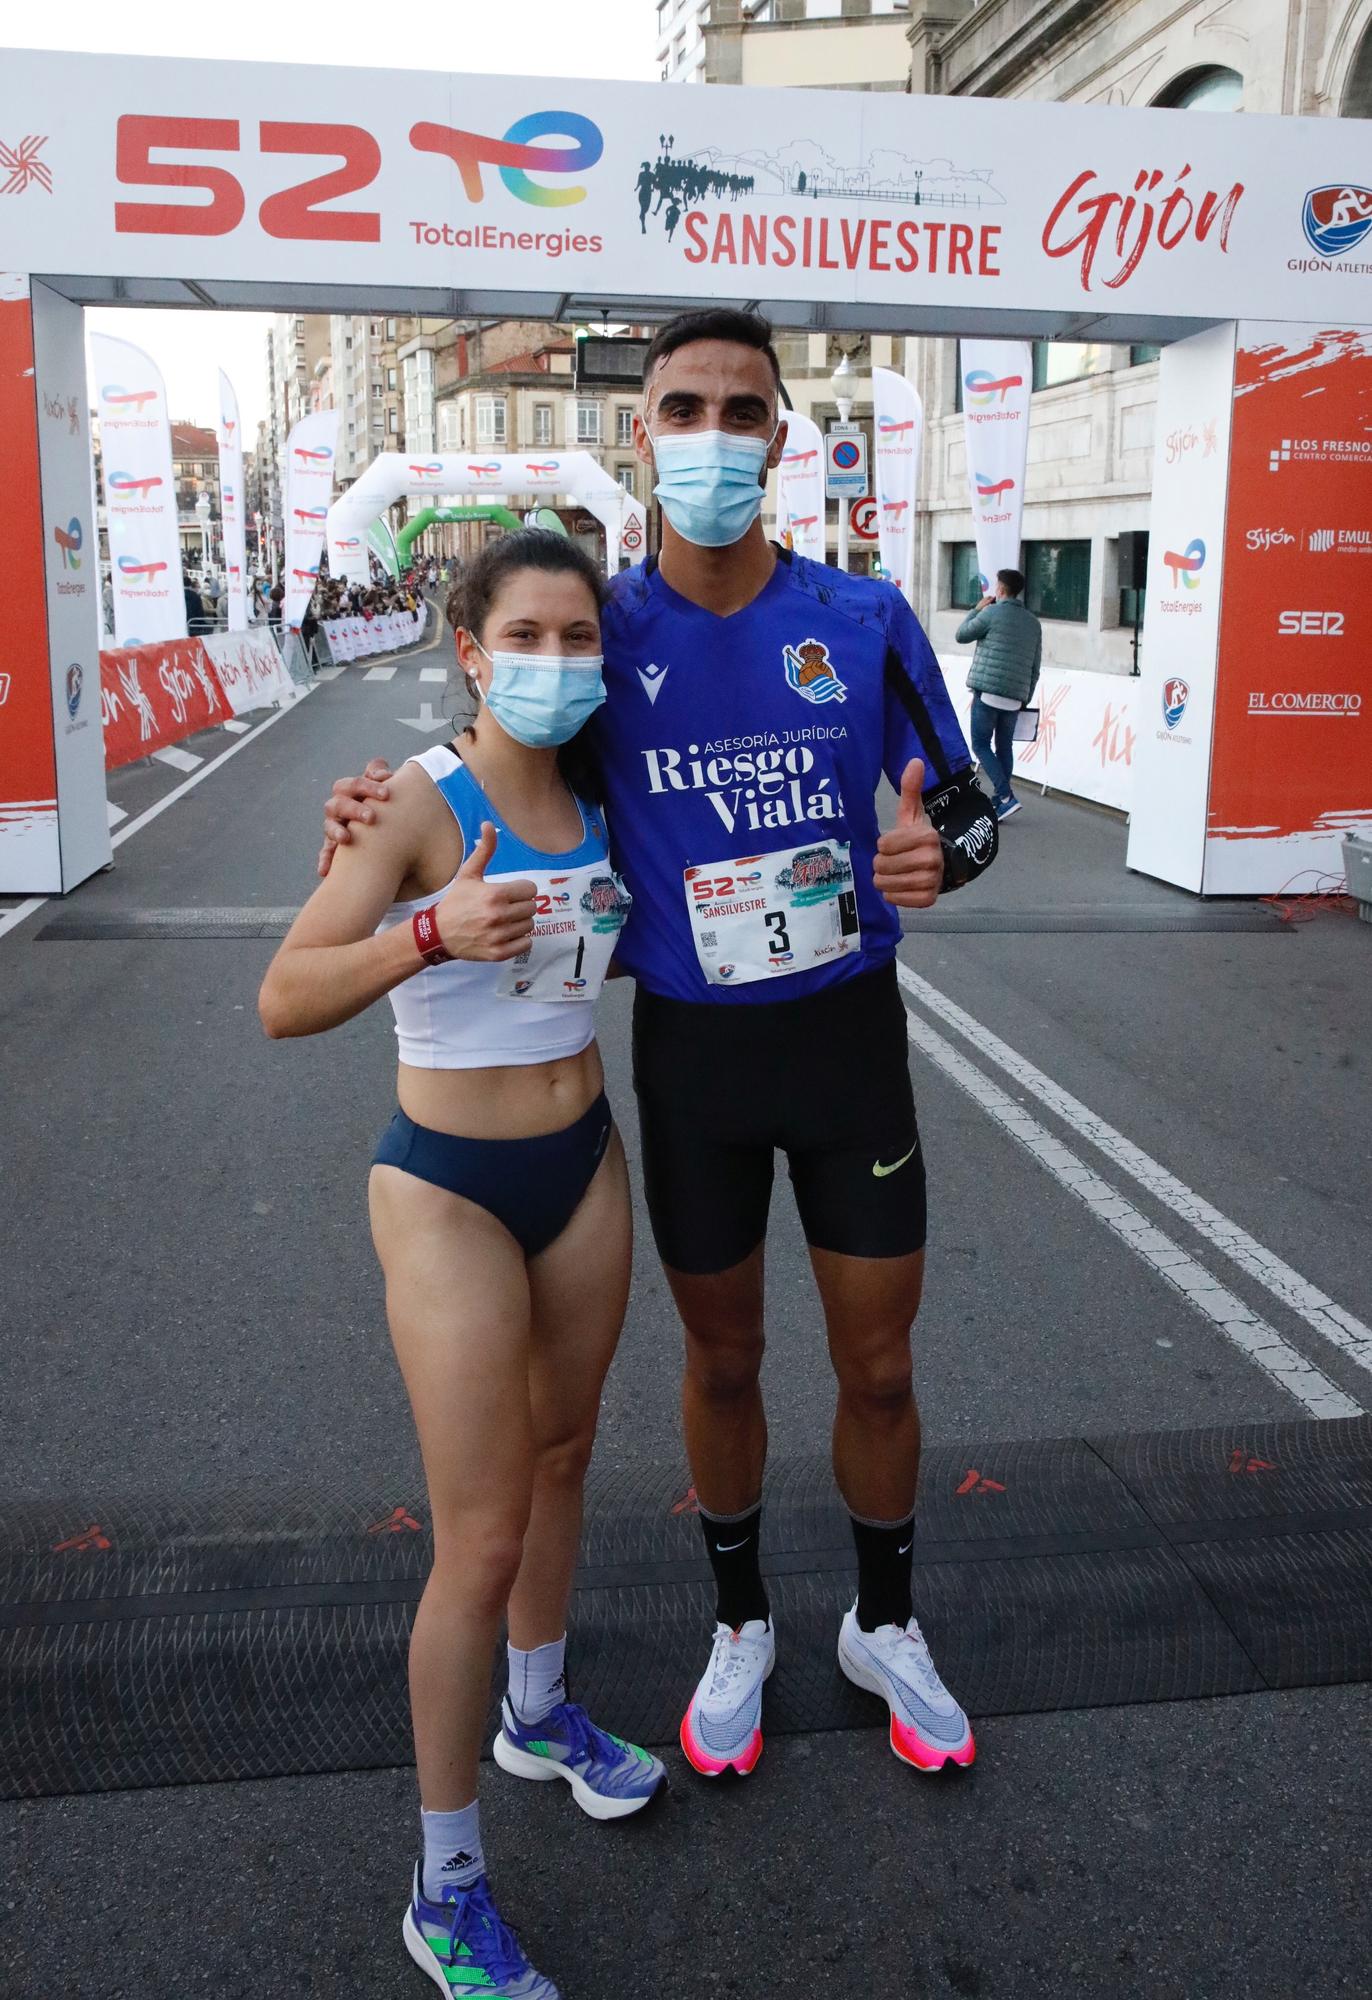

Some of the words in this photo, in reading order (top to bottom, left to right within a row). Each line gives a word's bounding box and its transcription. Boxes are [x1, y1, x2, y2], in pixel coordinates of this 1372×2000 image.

[114, 114, 381, 243] 52
[1041, 162, 1244, 292] Gijón
[409, 222, 603, 258] TotalEnergies
[684, 211, 1002, 277] SANSILVESTRE
[1287, 256, 1333, 273] GIJÓN
[1293, 439, 1318, 451] LOS
[1322, 440, 1372, 453] FRESNO
[1293, 452, 1327, 461] CENTRO
[1246, 527, 1296, 552] gijón
[1160, 600, 1203, 616] TotalEnergies
[1278, 610, 1345, 636] SER
[1247, 692, 1269, 708] EL
[1271, 692, 1362, 710] COMERCIO
[704, 731, 779, 755] ASESORÍA
[782, 724, 848, 744] JURÍDICA
[640, 743, 815, 796] Riesgo
[692, 876, 736, 901] 52
[534, 894, 552, 915] 2
[703, 898, 768, 919] SANSILVESTRE
[764, 910, 791, 955] 3
[574, 936, 585, 978] 1
